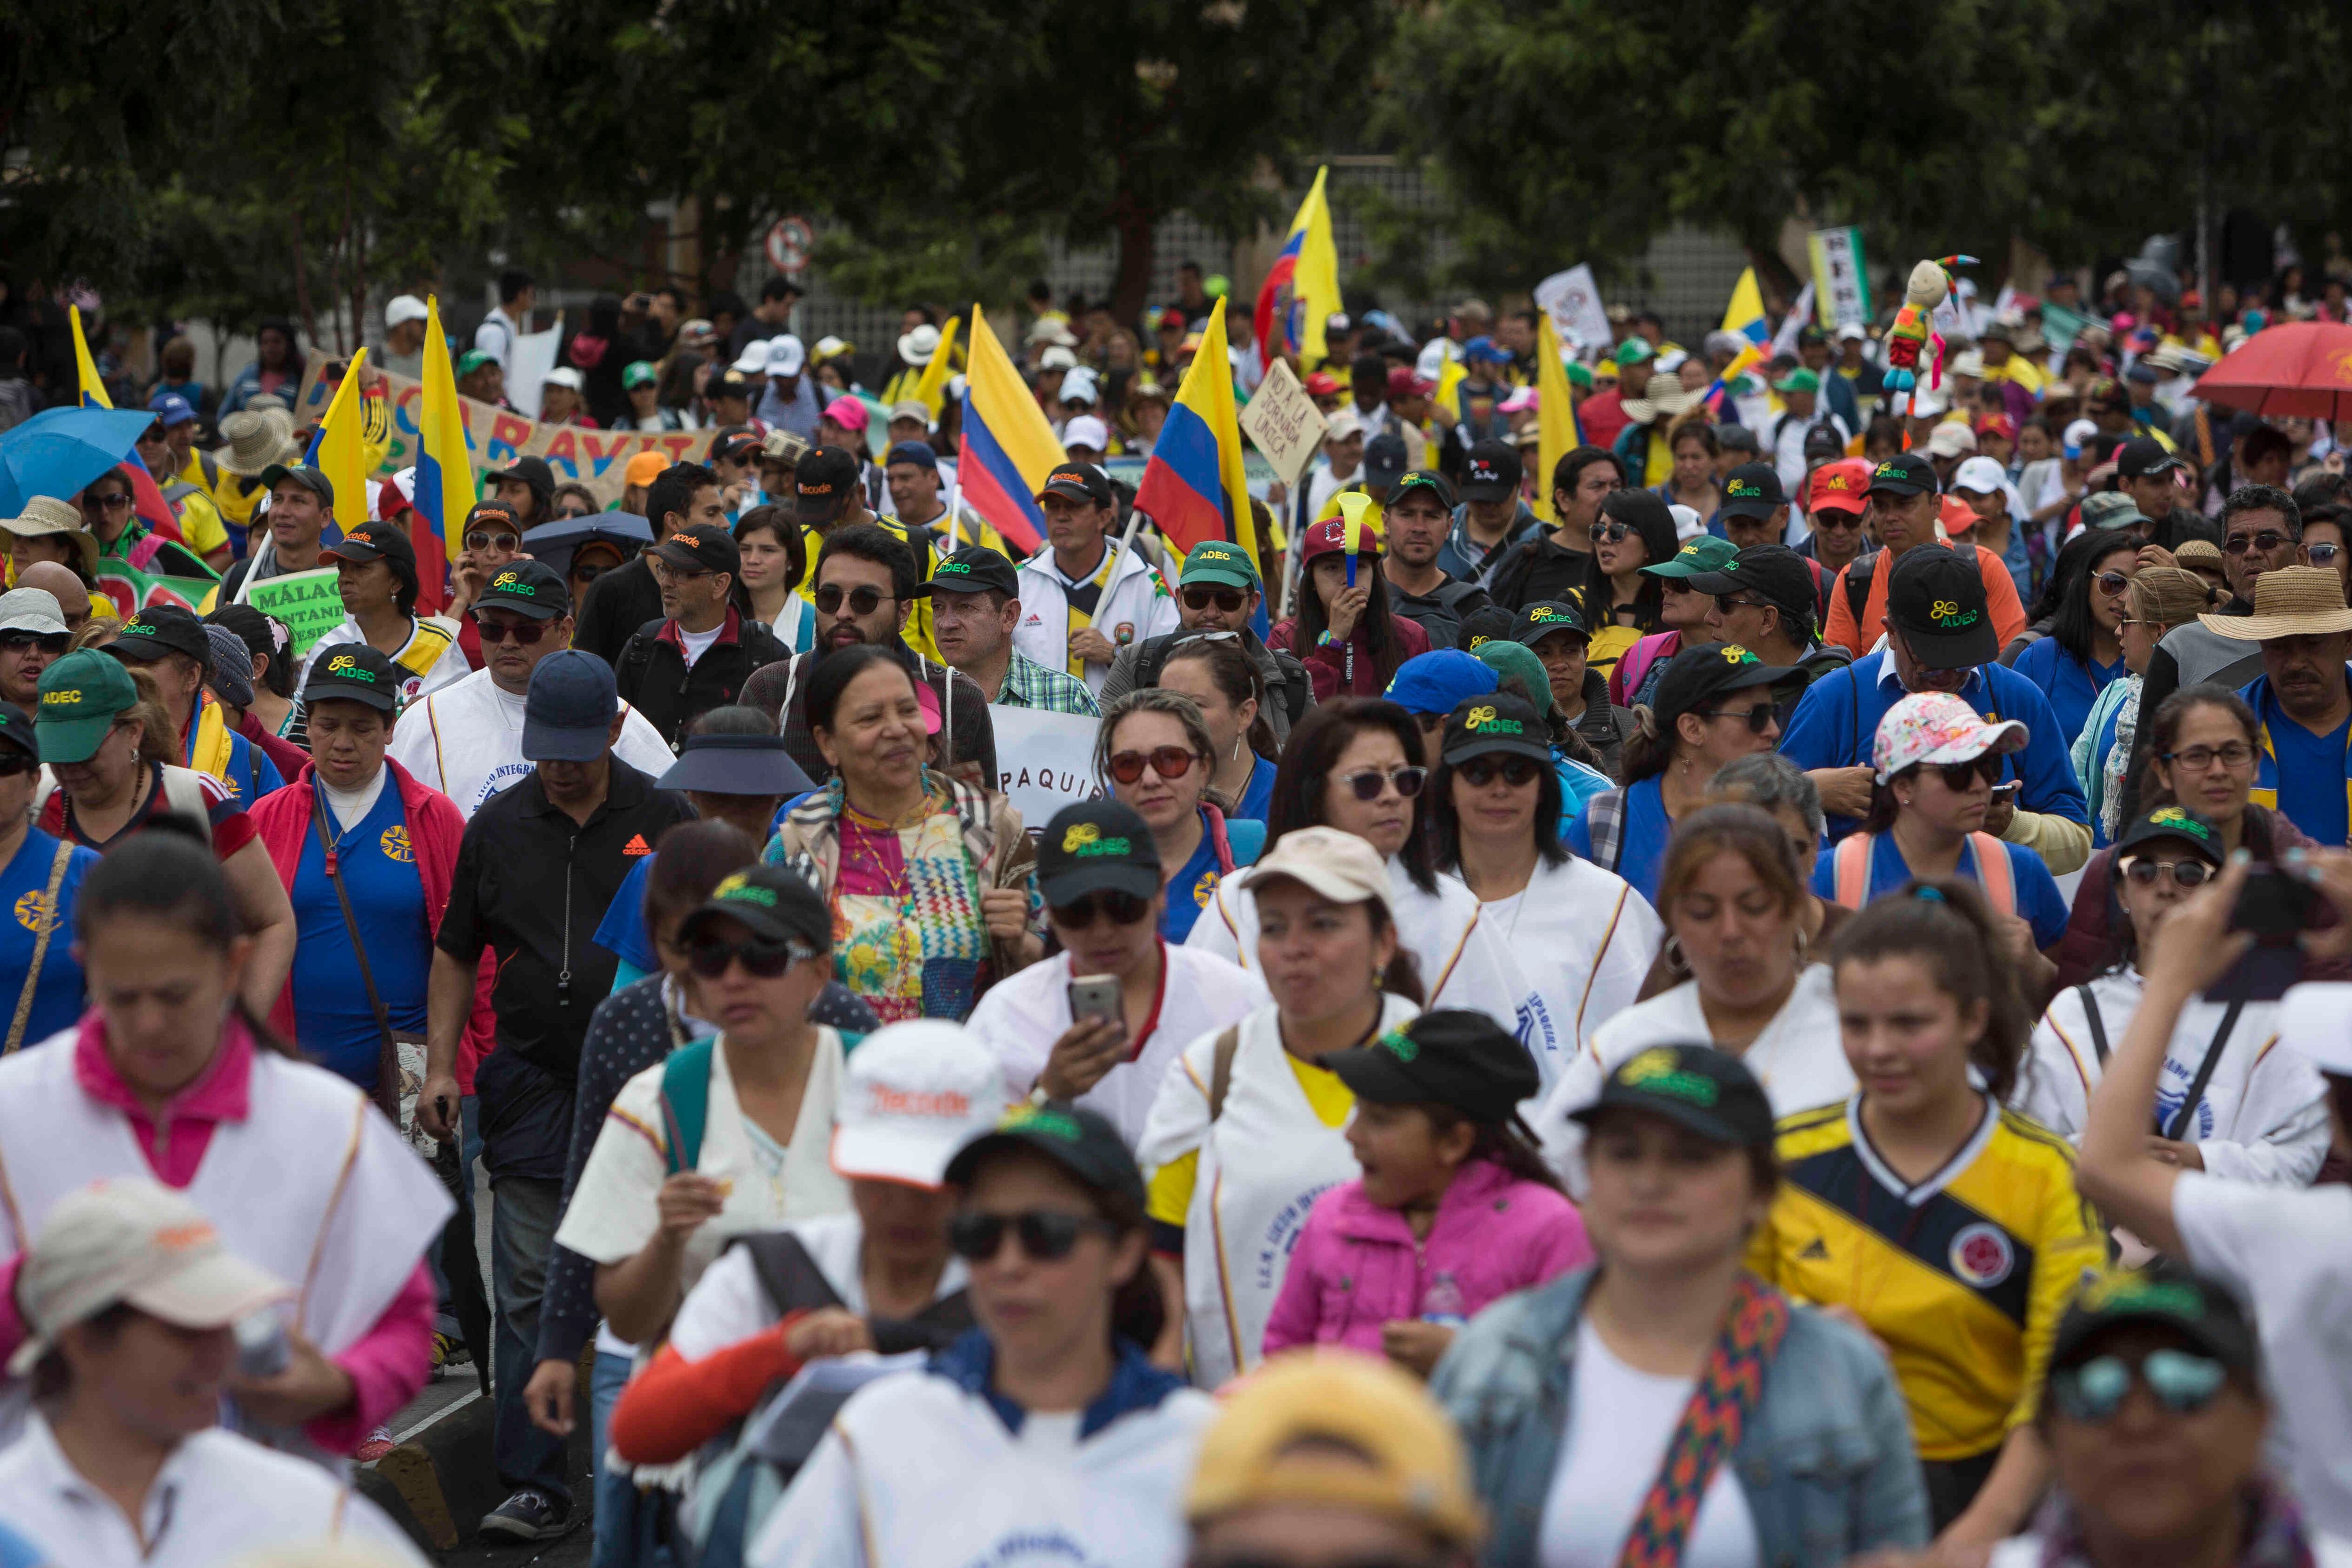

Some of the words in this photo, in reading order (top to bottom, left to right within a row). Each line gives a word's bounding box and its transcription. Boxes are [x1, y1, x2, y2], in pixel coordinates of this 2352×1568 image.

[1269, 368, 1286, 395] NO
[1283, 390, 1293, 407] A
[1292, 402, 1309, 429] LA
[1261, 391, 1300, 448] JORNADA
[1254, 413, 1286, 460] UNICA
[1878, 469, 1908, 479] ADEC
[1732, 486, 1762, 497] ADEC
[1199, 550, 1231, 561] ADEC
[937, 563, 971, 574] ADEC
[497, 582, 535, 597] ADEC
[1538, 613, 1573, 625] ADEC
[1940, 609, 1978, 628] ADEC
[122, 624, 157, 635] ADEC
[335, 667, 375, 683] ADEC
[43, 689, 81, 704] ADEC
[1476, 718, 1524, 735] ADEC
[478, 773, 495, 798] LICEO
[1075, 836, 1132, 859] ADEC
